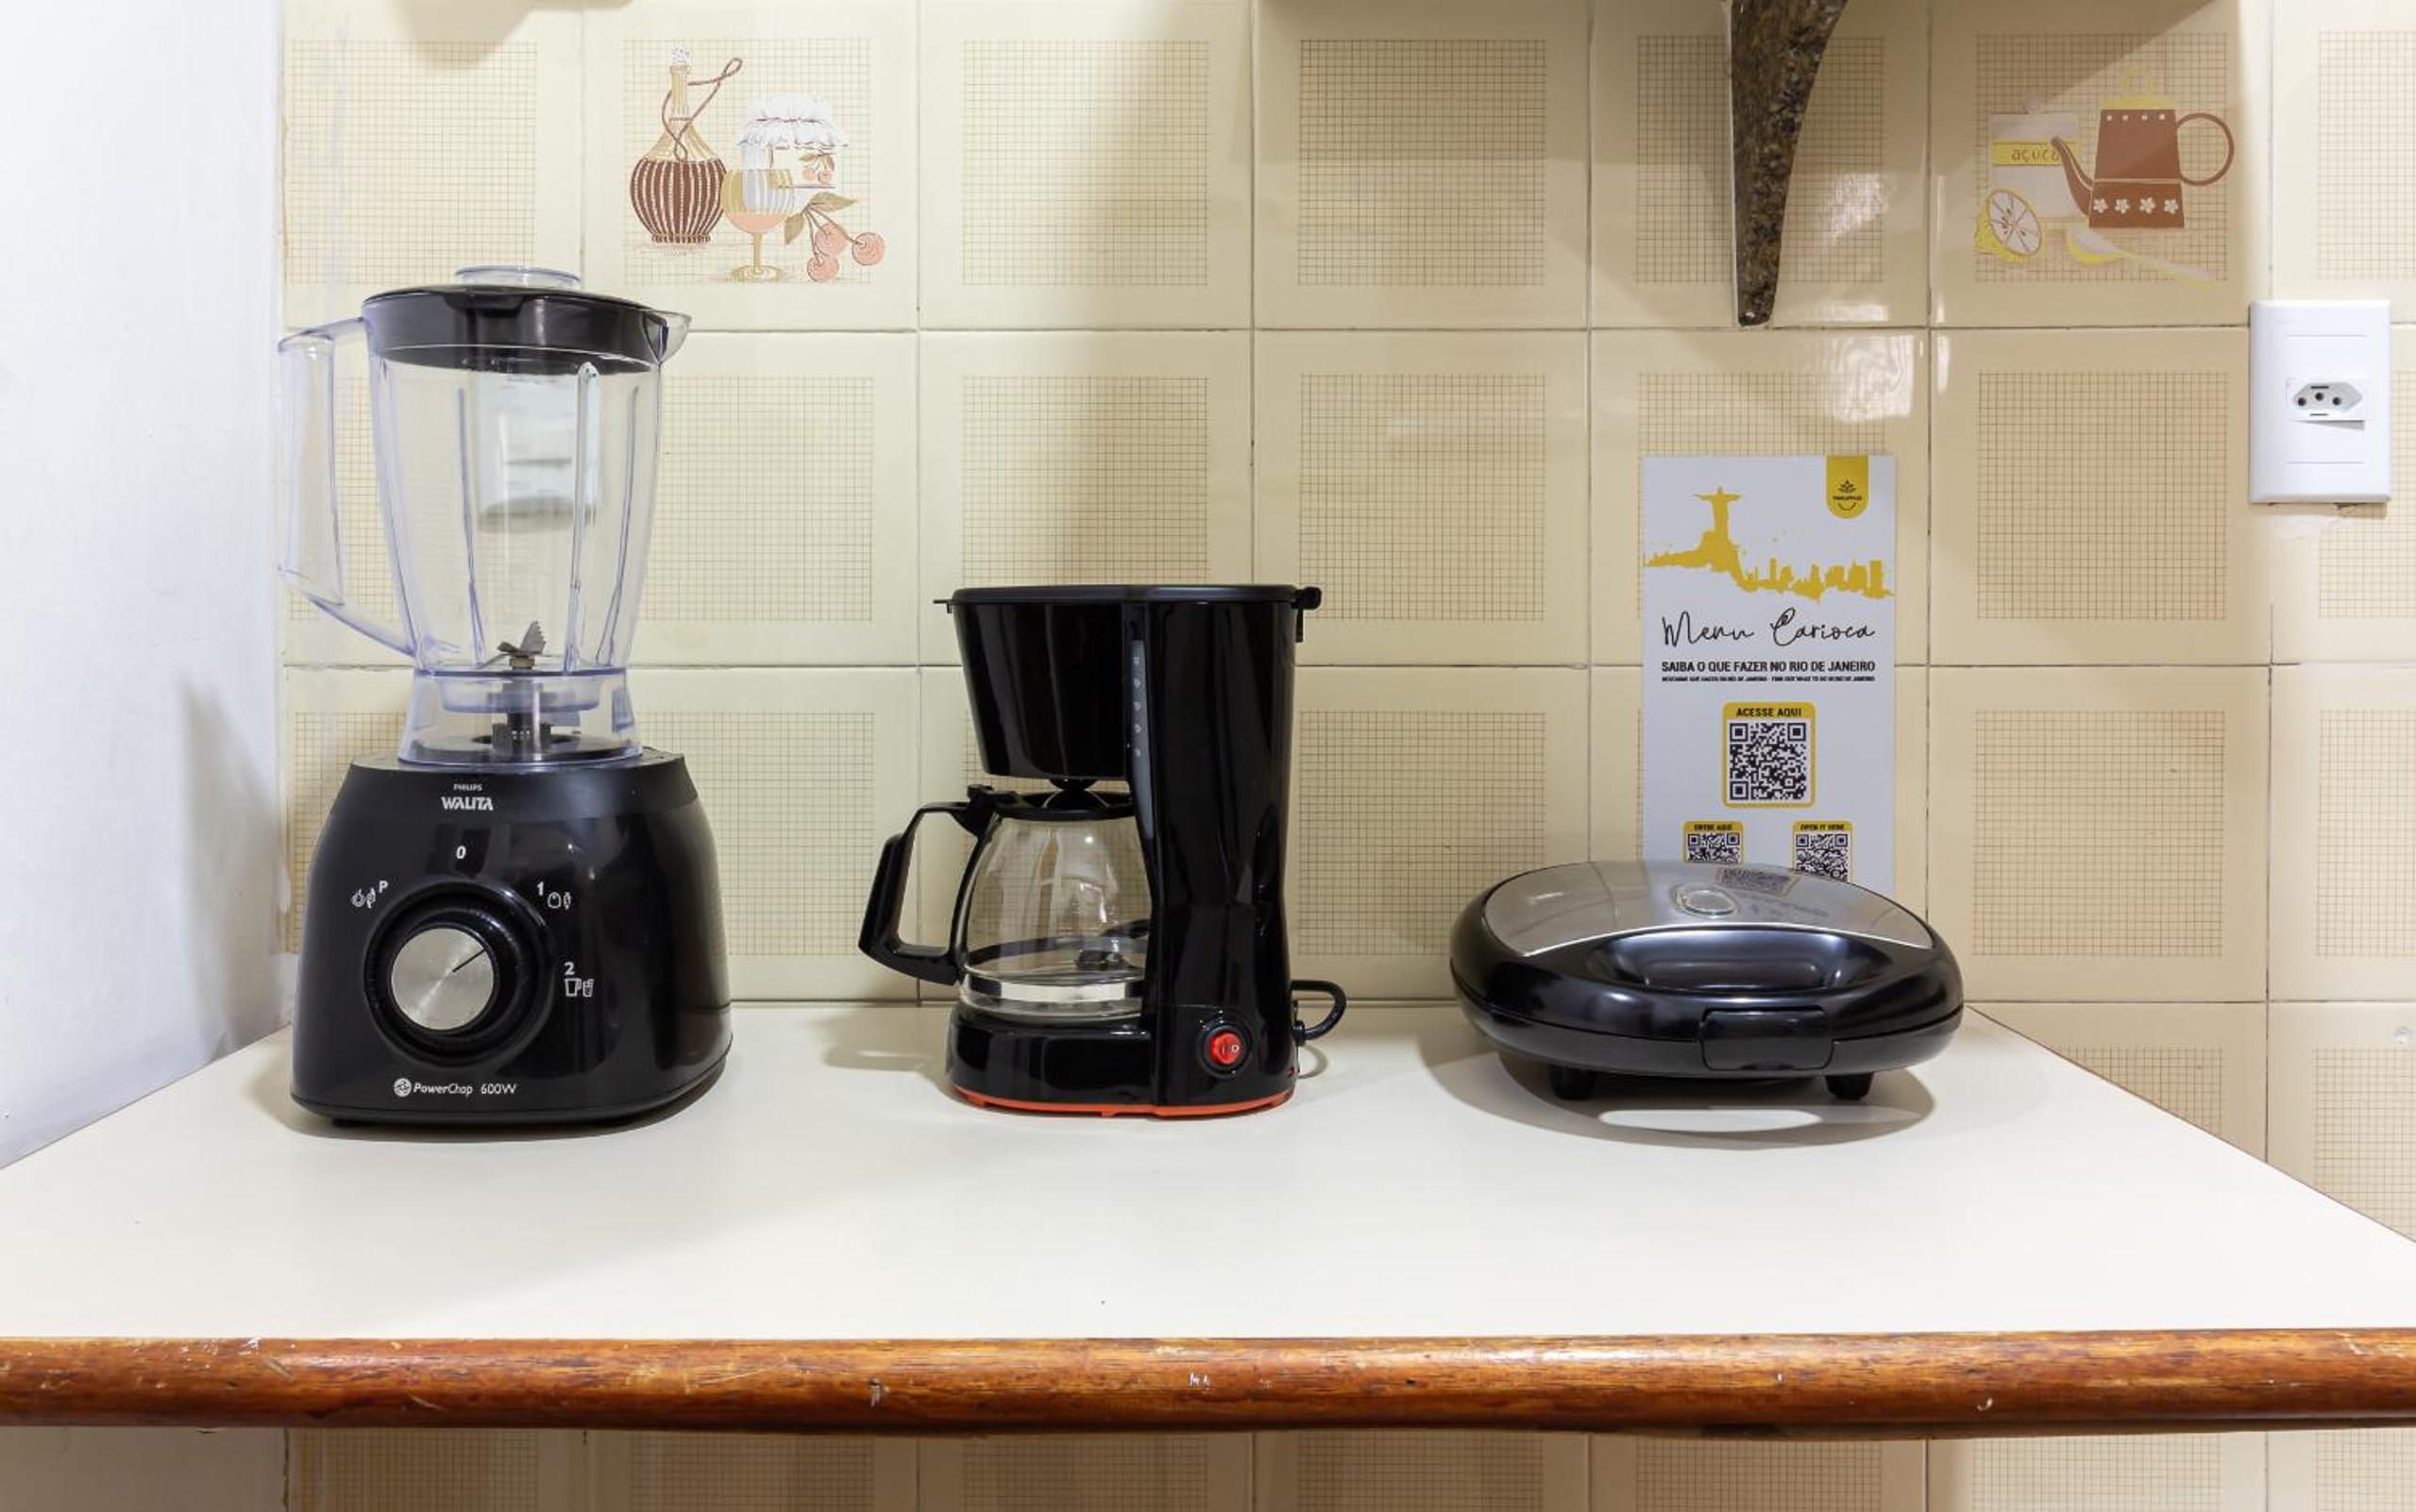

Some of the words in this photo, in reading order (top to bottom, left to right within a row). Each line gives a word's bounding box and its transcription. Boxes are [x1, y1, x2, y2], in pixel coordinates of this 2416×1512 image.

[1662, 611, 1755, 647] Menu
[1770, 607, 1876, 647] Carioca
[1662, 661, 1695, 672] SAIBA
[1697, 661, 1706, 672] O
[1708, 661, 1731, 672] QUE
[1733, 661, 1767, 672] FAZER
[1769, 661, 1787, 672] NO
[1789, 661, 1808, 672] RIO
[1811, 661, 1825, 672] DE
[1828, 661, 1876, 672] JANEIRO
[1736, 708, 1774, 717] ACESSE
[1777, 708, 1802, 717] AQUI
[440, 796, 494, 811] WALITA
[379, 880, 389, 894] P
[536, 882, 544, 897] 1
[565, 962, 575, 975] 2
[414, 1082, 473, 1098] PowerChop
[481, 1083, 517, 1095] 600W
